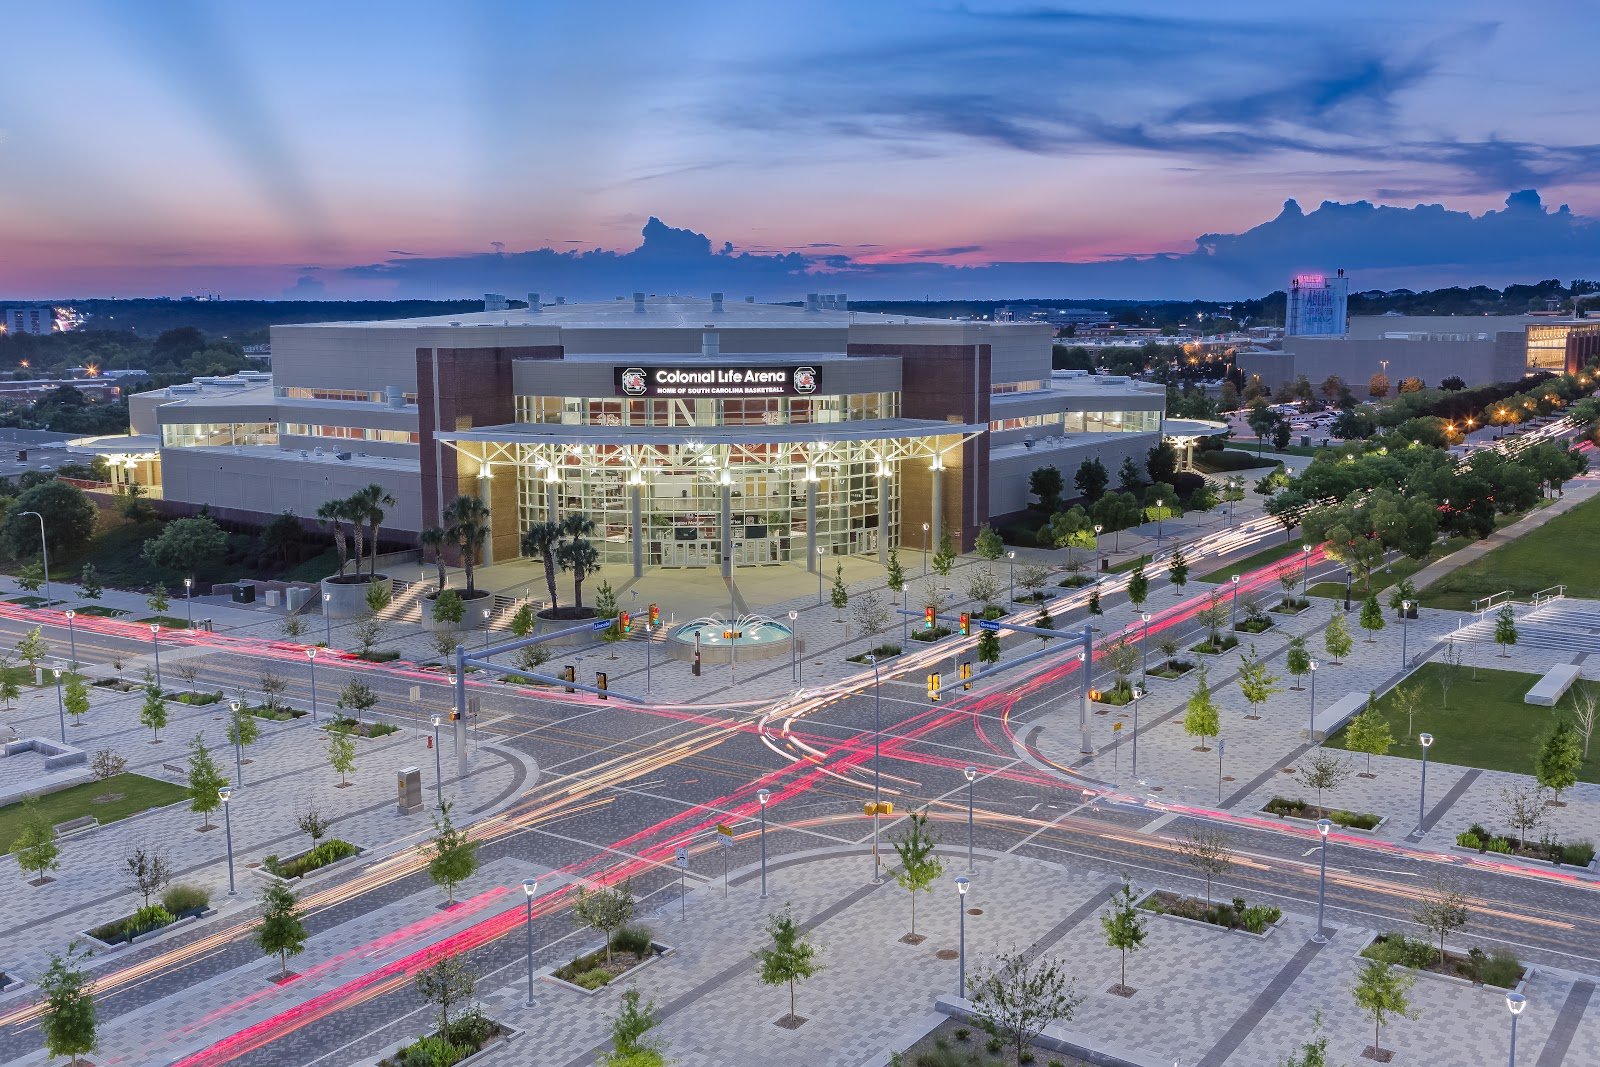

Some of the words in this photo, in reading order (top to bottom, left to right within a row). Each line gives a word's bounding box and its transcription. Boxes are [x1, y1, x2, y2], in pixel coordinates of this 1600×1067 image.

[656, 370, 714, 383] Colonial
[718, 370, 742, 383] Life
[744, 370, 785, 382] Arena
